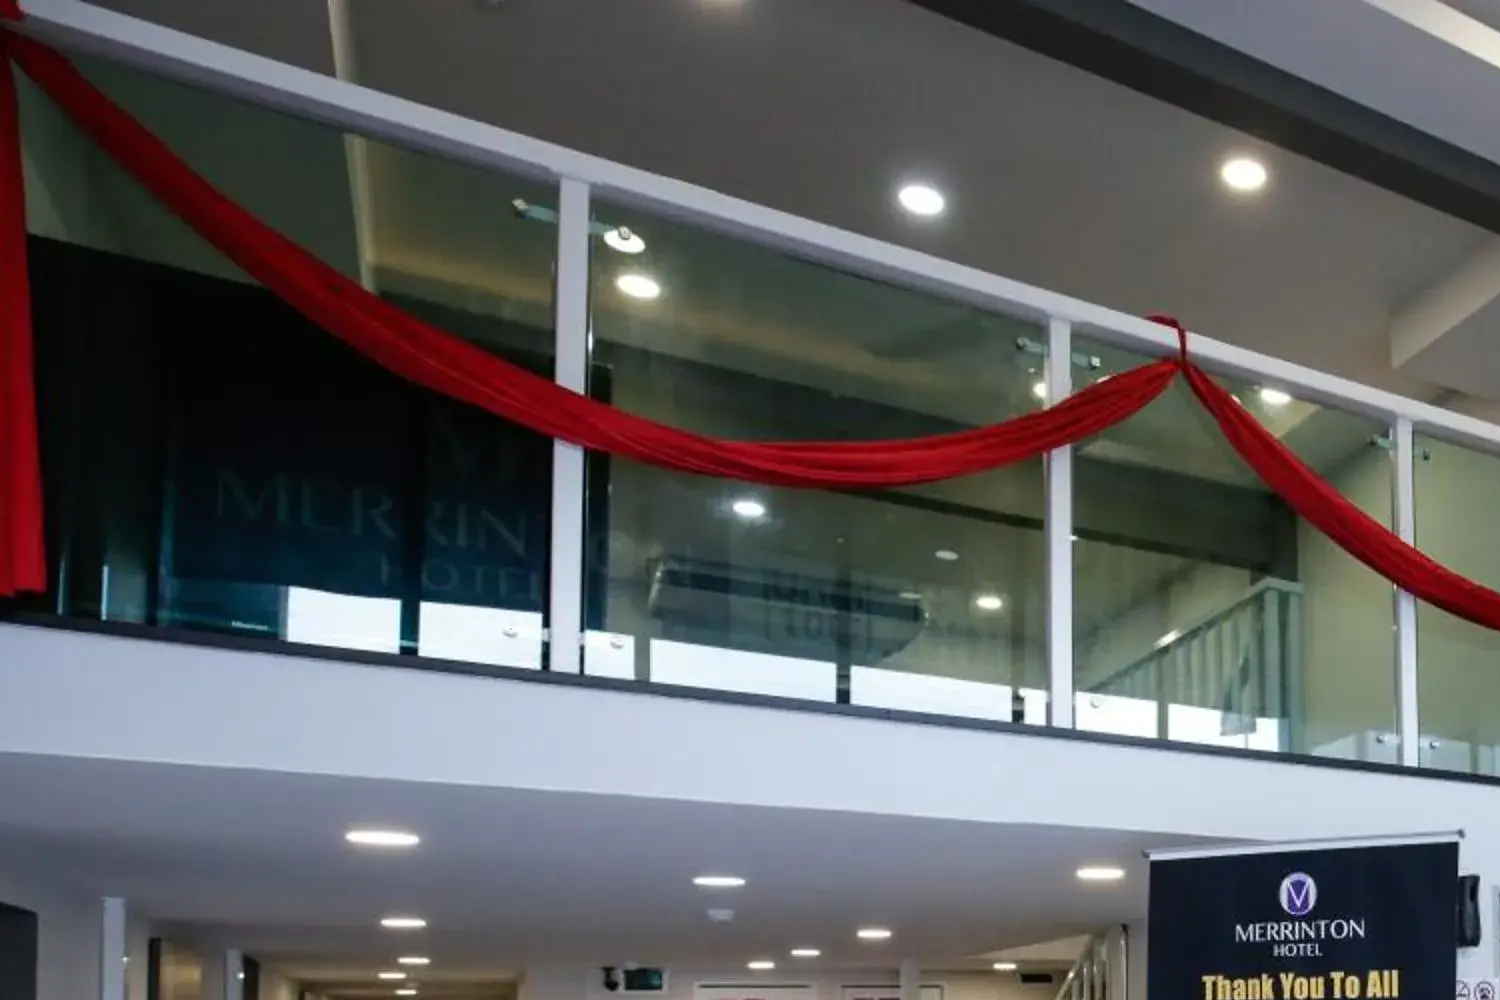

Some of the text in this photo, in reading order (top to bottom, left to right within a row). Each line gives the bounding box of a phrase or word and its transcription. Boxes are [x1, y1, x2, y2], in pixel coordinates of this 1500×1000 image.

[1235, 919, 1366, 943] MERRINTON
[1273, 944, 1323, 957] HOTEL
[1280, 972, 1324, 1000] You
[1330, 971, 1361, 999] To
[1367, 969, 1399, 998] All
